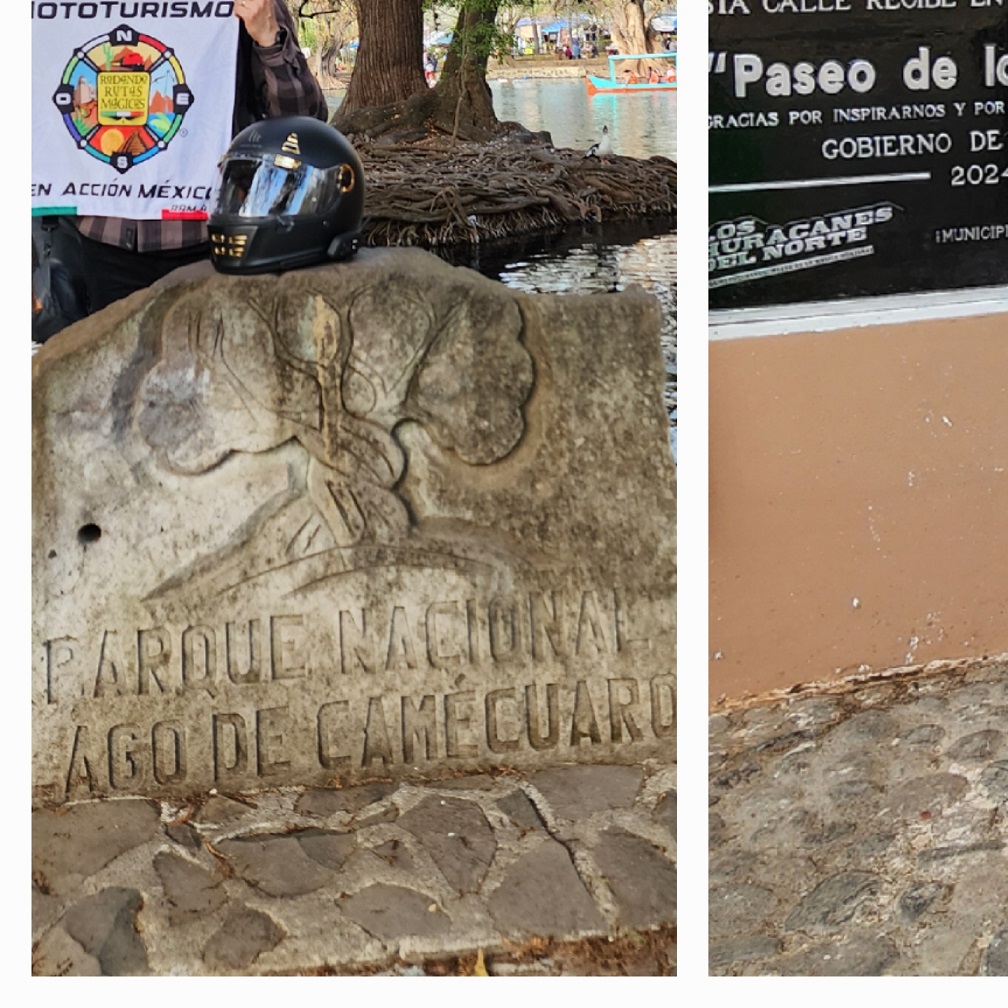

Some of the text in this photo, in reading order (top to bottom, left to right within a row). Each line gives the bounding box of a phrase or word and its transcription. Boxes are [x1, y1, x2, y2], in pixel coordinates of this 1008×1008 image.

[116, 30, 133, 42] N
[902, 45, 958, 91] de
[55, 92, 72, 105] O
[176, 92, 190, 106] E
[788, 109, 823, 127] POR
[832, 102, 946, 124] INSPIRARNOS
[953, 101, 967, 119] Y
[973, 99, 1006, 117] POR
[821, 132, 953, 161] GOBIERNO
[968, 128, 1005, 153] DE
[116, 154, 128, 169] S
[62, 178, 133, 198] ACCIÓN
[762, 226, 868, 262] NORTE
[44, 587, 651, 705] PARQUE NACIONAL
[64, 672, 677, 793] AGO DE CAMÉCUARO
